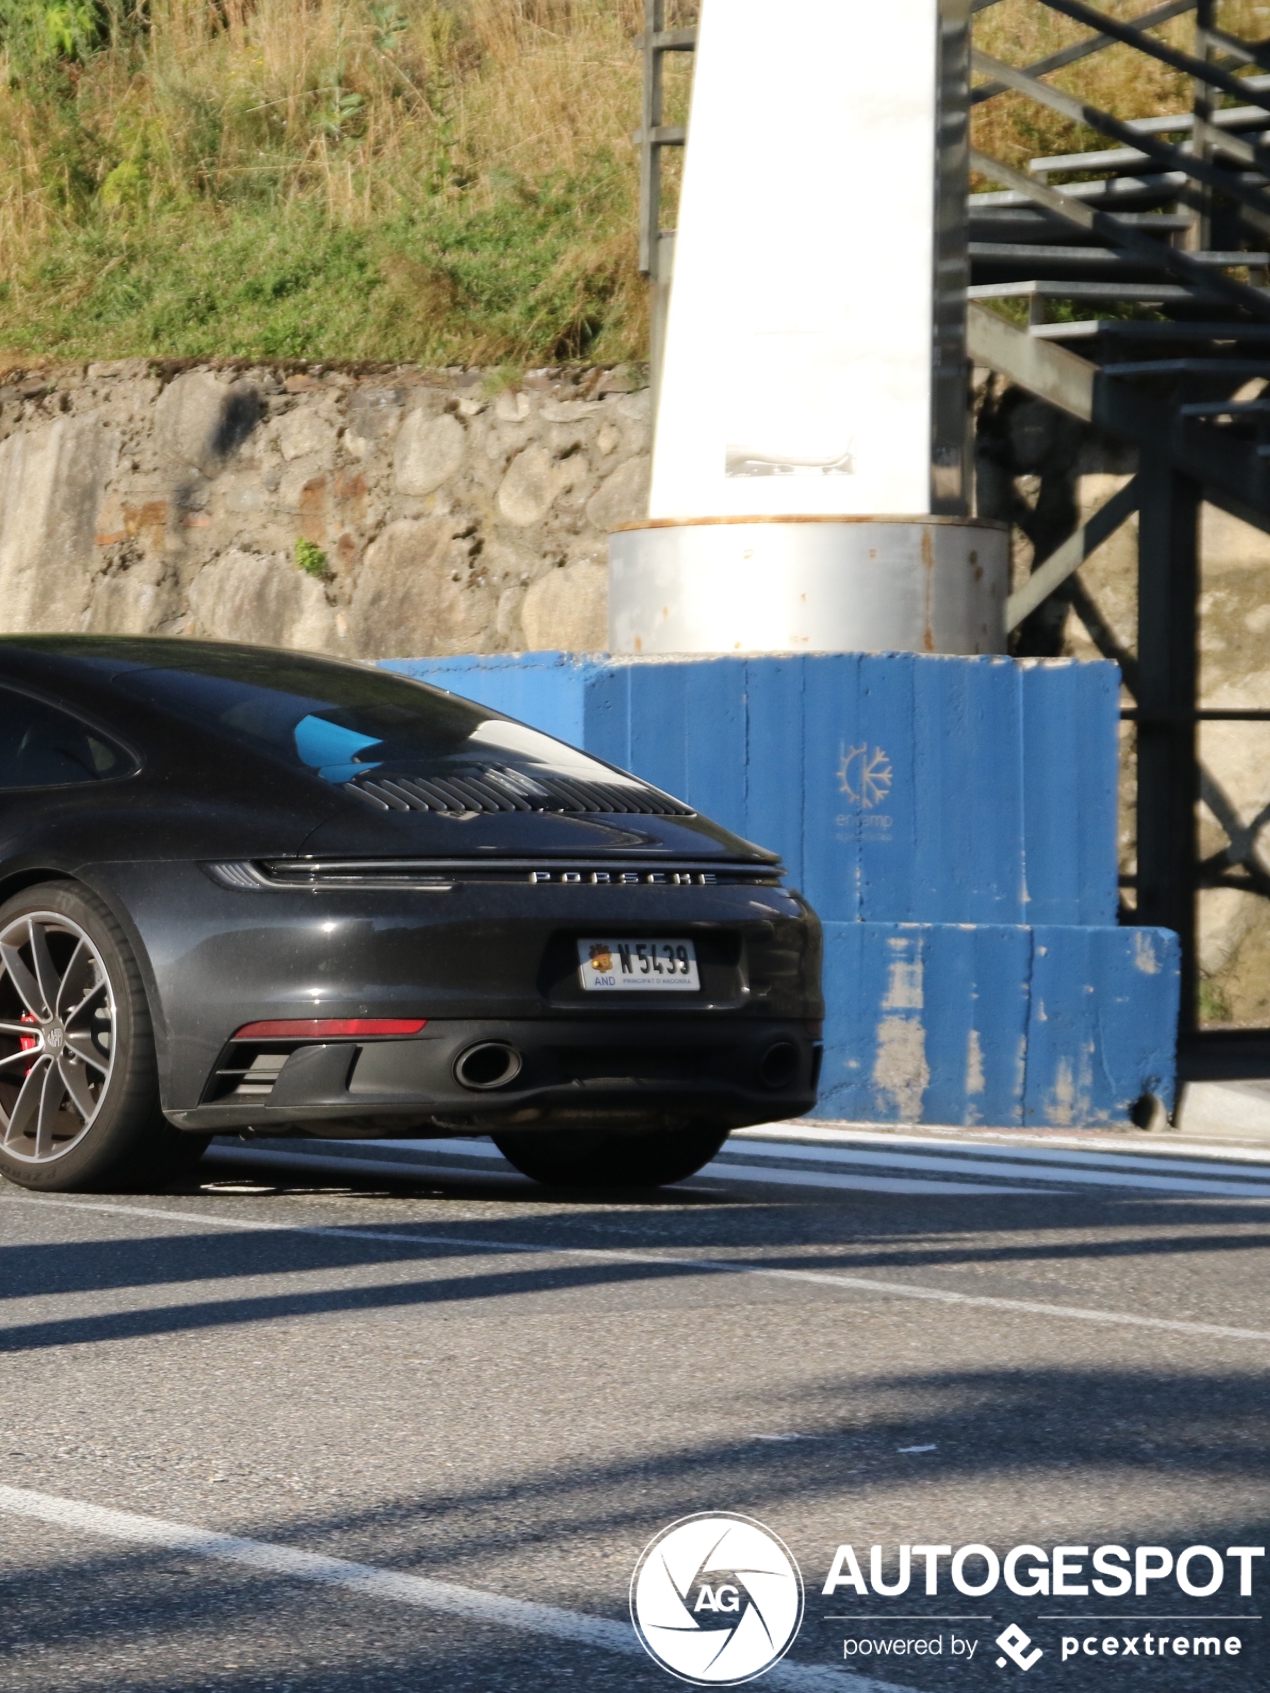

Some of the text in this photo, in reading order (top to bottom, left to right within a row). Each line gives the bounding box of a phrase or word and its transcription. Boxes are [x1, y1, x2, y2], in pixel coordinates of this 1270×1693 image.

[530, 871, 717, 885] PORSCHE
[617, 943, 691, 975] N 5439
[594, 976, 616, 986] AND
[622, 977, 655, 985] PRINCIPAT
